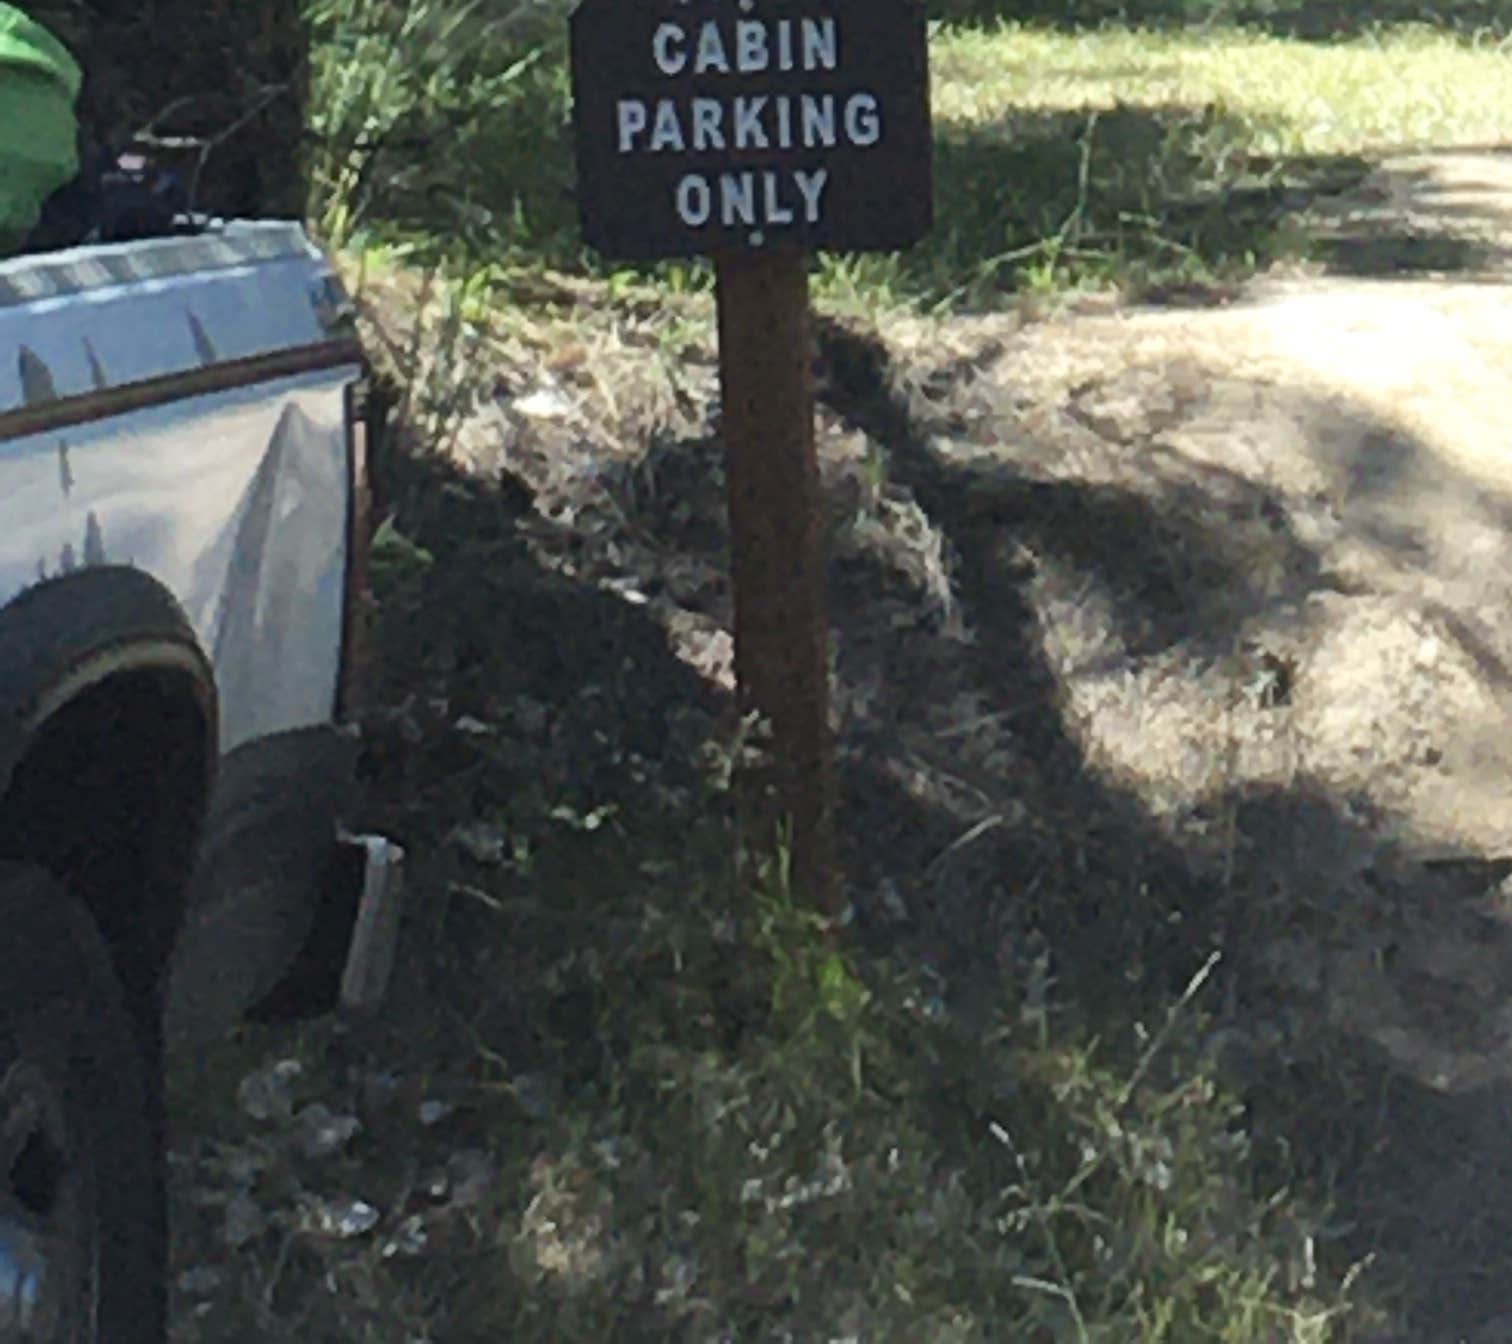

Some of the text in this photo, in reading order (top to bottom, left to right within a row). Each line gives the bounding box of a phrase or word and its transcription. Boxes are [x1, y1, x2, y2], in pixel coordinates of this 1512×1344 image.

[652, 16, 837, 75] CABIN
[617, 92, 881, 152] PARKING
[676, 168, 828, 226] ONLY
